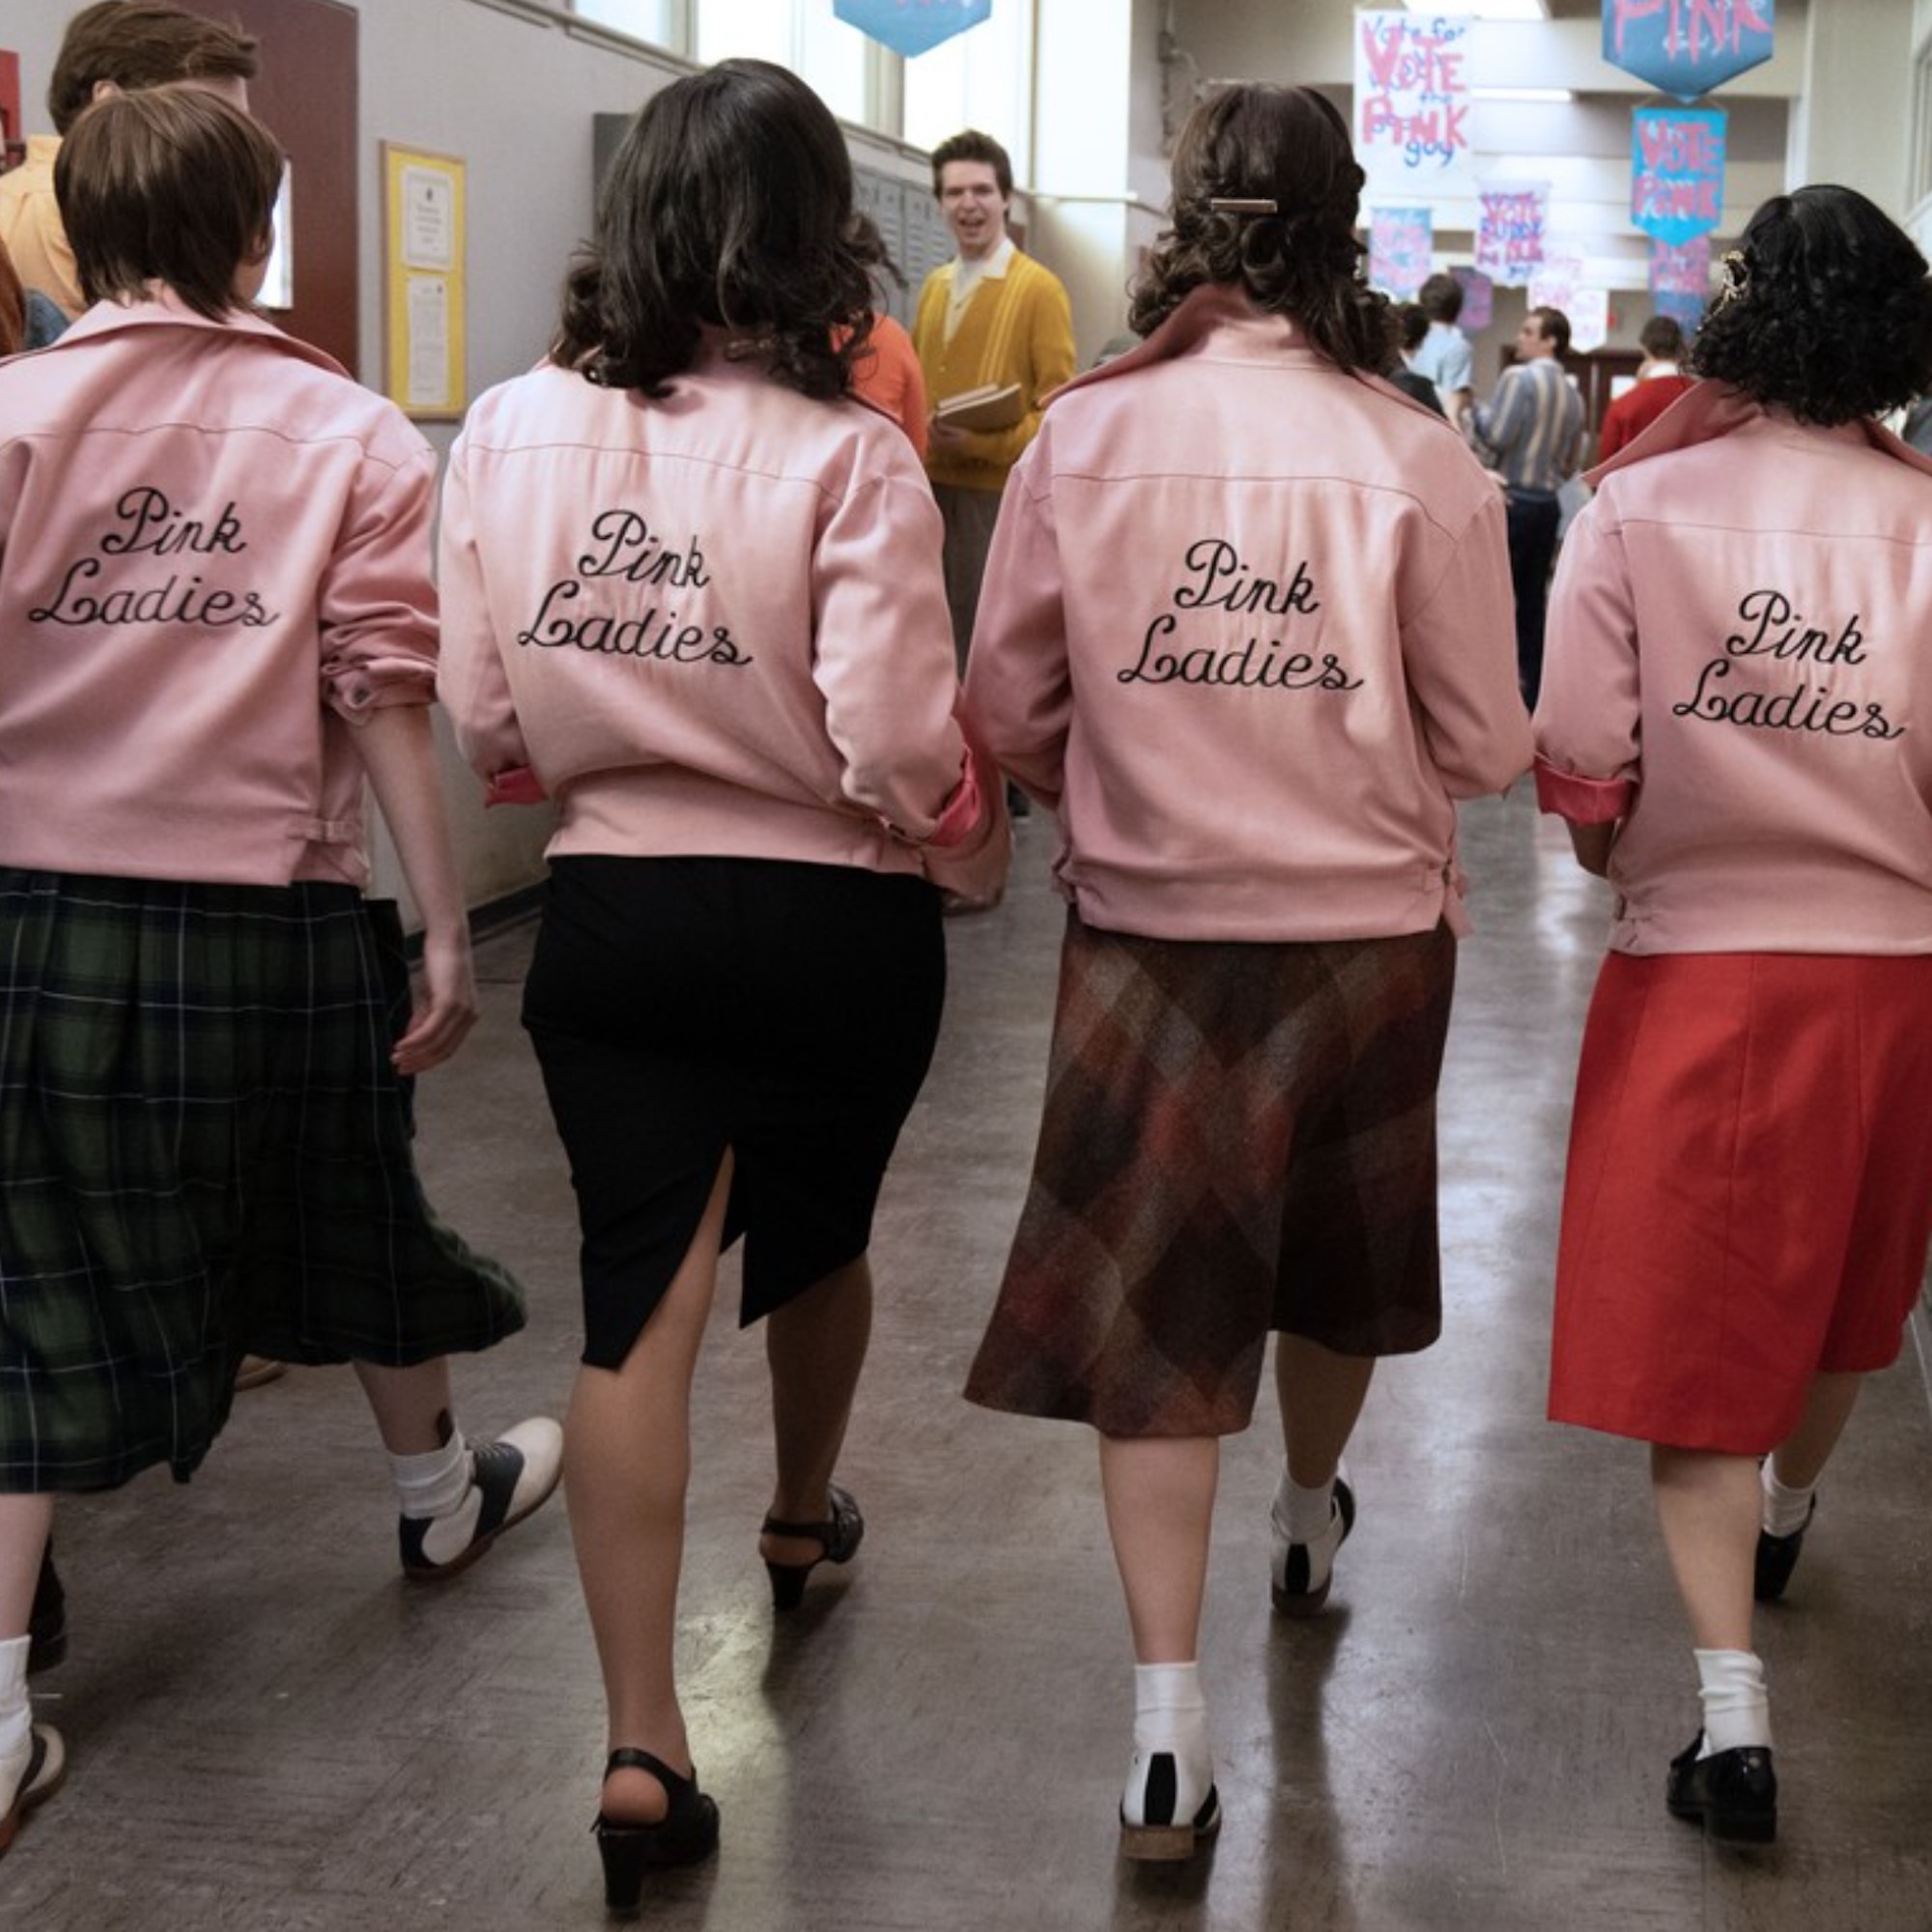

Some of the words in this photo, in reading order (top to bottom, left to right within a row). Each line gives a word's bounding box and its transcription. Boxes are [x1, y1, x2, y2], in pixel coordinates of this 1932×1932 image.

[1361, 19, 1466, 93] VOTE
[1362, 95, 1469, 151] PINK
[1404, 141, 1455, 168] guy
[1636, 118, 1720, 175] VOTE
[100, 486, 247, 555] Pink
[577, 509, 710, 588] Pink
[28, 557, 280, 627] Ladies
[1174, 539, 1320, 614] Pink
[517, 580, 753, 666] Ladies
[1117, 613, 1364, 690] Ladies
[1726, 589, 1866, 665] Pink
[1672, 659, 1906, 740] Ladies
